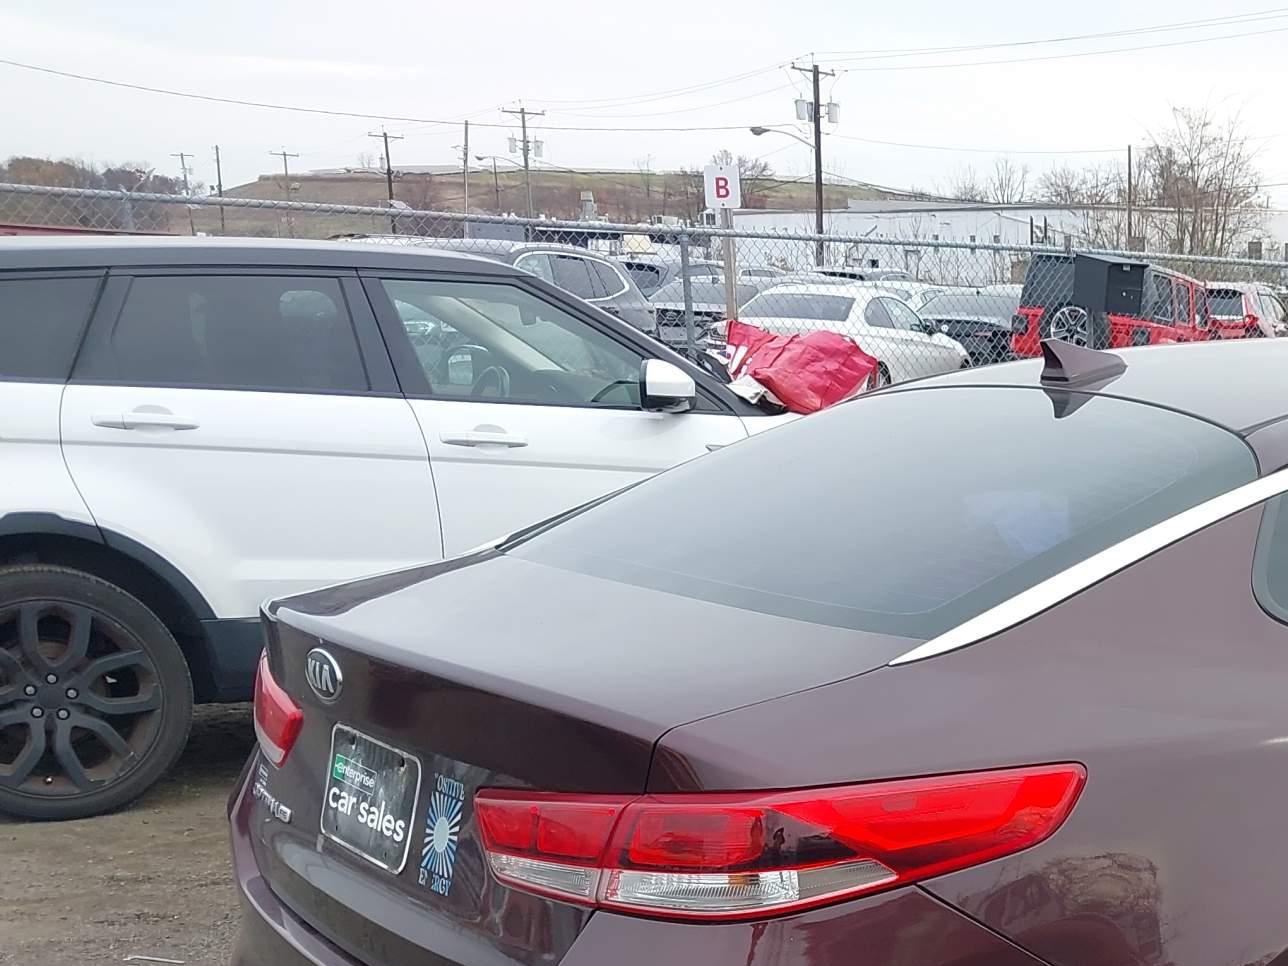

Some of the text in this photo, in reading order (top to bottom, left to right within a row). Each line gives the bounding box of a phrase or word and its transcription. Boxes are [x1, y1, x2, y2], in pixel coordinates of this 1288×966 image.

[715, 177, 730, 199] B
[307, 658, 335, 694] KIA
[335, 761, 376, 788] enterprise
[434, 773, 465, 801] OSITIVE
[329, 787, 357, 815] car
[357, 801, 405, 842] sales
